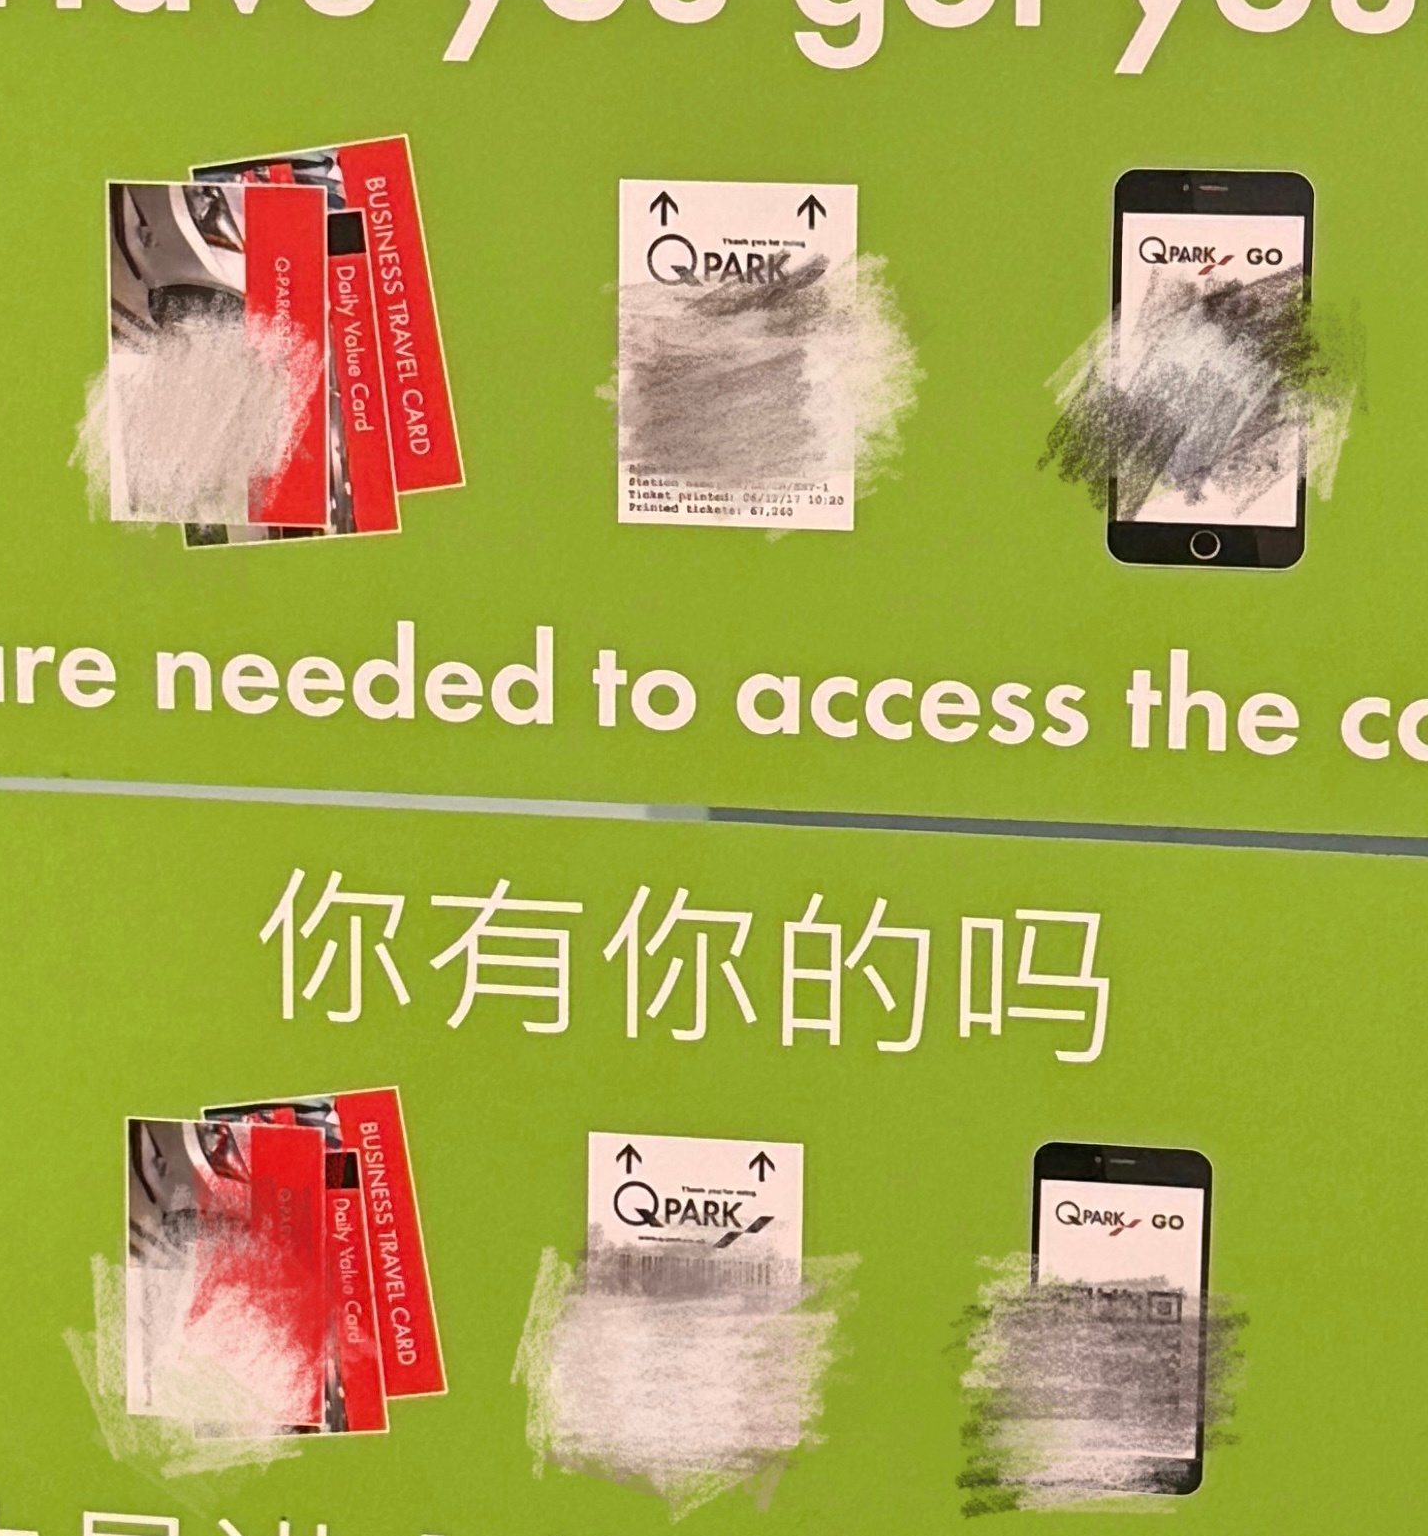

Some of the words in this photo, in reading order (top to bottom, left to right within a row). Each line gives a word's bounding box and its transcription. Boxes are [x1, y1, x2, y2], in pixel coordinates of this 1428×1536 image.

[364, 175, 404, 296] BUSINESS
[1246, 247, 1283, 266] GO
[335, 264, 356, 316] Daily
[343, 320, 362, 378] Value
[386, 301, 418, 384] TRAVEL
[349, 382, 374, 432] Card
[401, 390, 430, 456] CARD
[628, 490, 672, 500] Ticket
[628, 502, 679, 514] Printed
[155, 619, 555, 727] needed
[591, 648, 698, 732] to
[735, 672, 1090, 748] access
[1124, 647, 1301, 757] the
[258, 867, 1111, 1064] 你有你的吗
[359, 1121, 394, 1226] BUSINESS
[332, 1197, 350, 1243] Daily
[1151, 1214, 1185, 1231] GO
[338, 1246, 355, 1296] Value
[378, 1230, 405, 1305] TRAVEL
[343, 1300, 365, 1345] Card
[390, 1307, 417, 1366] CARD
